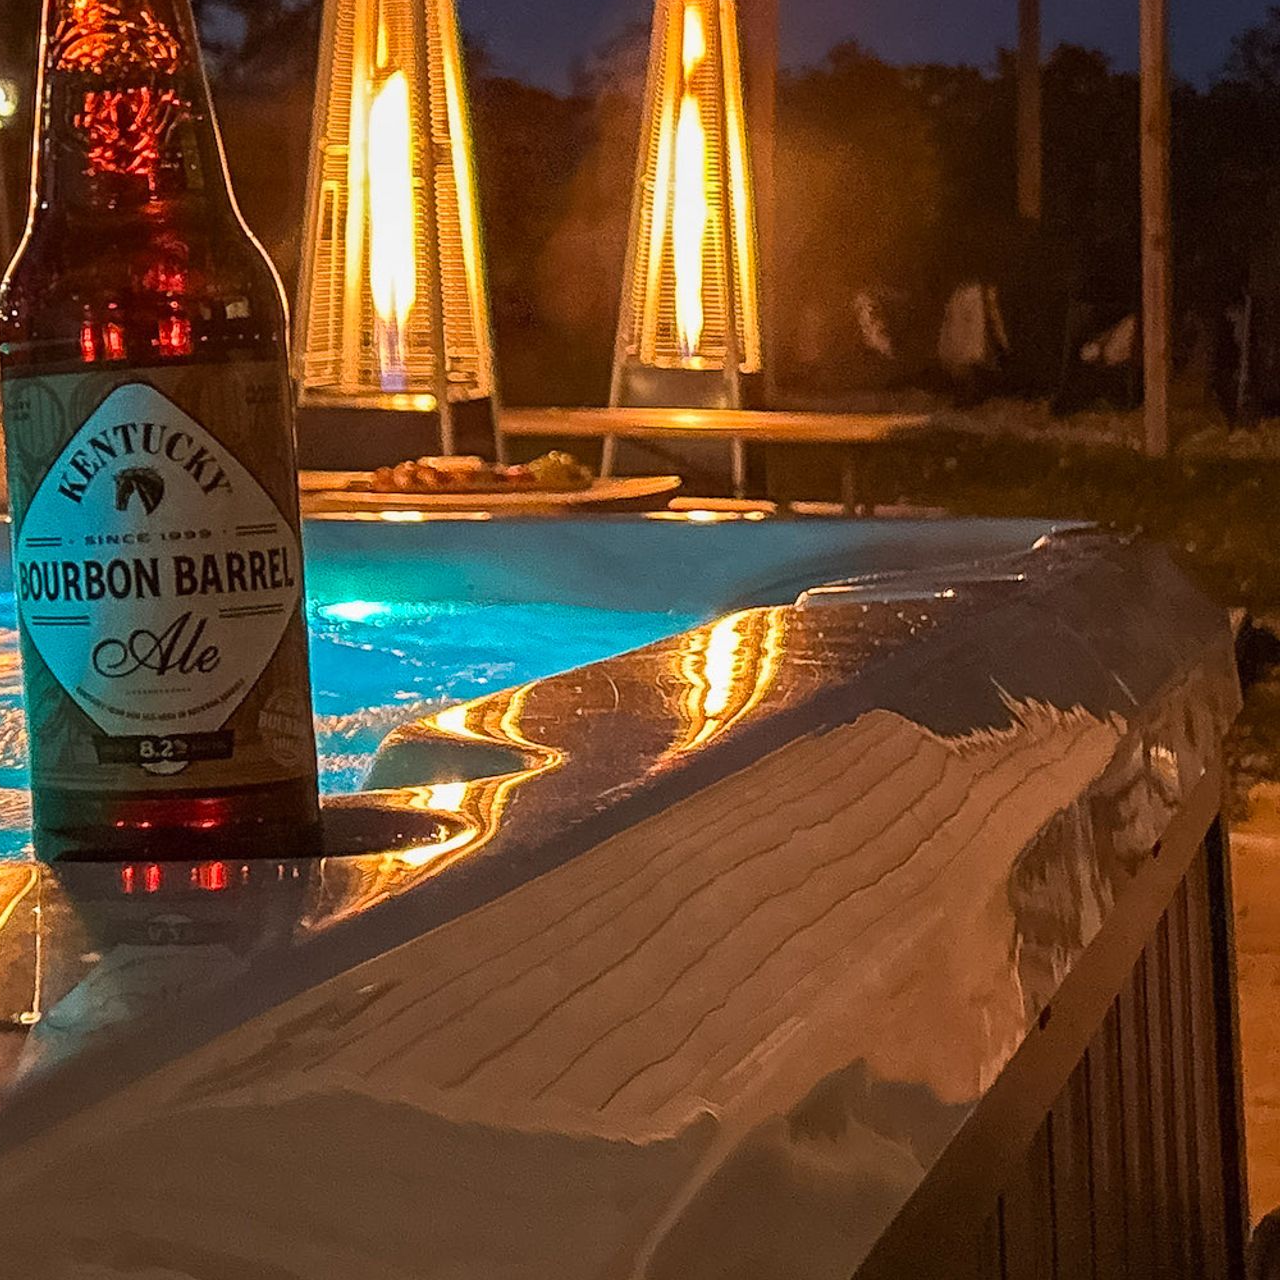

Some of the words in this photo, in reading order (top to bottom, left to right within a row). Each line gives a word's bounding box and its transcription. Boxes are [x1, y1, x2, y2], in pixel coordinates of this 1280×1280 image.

[57, 422, 233, 504] KENTUCKY
[84, 533, 150, 545] SINCE
[19, 557, 161, 602] BOURBON
[173, 547, 295, 596] BARREL
[92, 611, 221, 678] Ale
